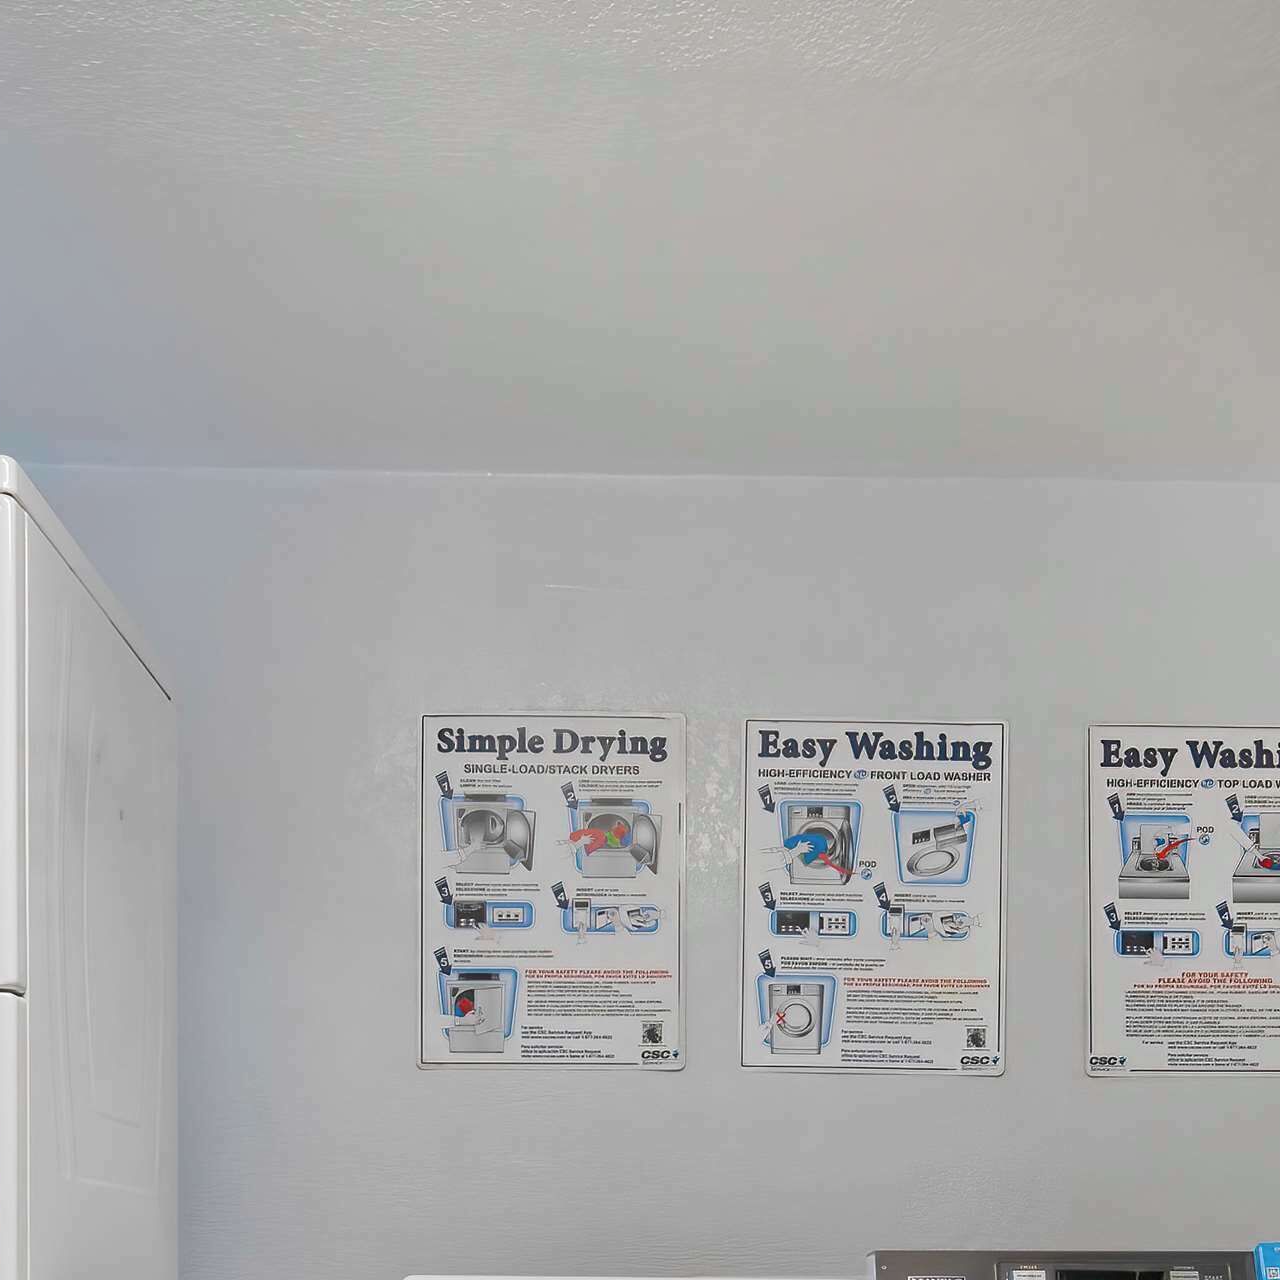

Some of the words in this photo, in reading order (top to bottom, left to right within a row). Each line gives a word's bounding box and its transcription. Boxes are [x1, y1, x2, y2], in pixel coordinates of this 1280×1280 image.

[437, 727, 544, 760] Simple
[553, 729, 668, 762] Drying
[758, 729, 838, 767] Easy
[846, 731, 993, 770] Washing
[1100, 740, 1178, 776] Easy
[464, 764, 588, 775] SINGLE-LOAD/STACK
[591, 765, 639, 775] DRYERS
[758, 769, 852, 779] HIGH-EFFICIENCY
[870, 771, 907, 780] FRONT
[910, 771, 941, 781] LOAD
[943, 772, 991, 782] WASHER
[1107, 779, 1199, 788] HIGH-EFFICIENCY
[1217, 780, 1239, 789] TOP
[1242, 780, 1273, 789] LOAD
[889, 795, 897, 805] 2
[1232, 805, 1239, 813] 2
[1196, 826, 1214, 834] POD
[858, 860, 877, 868] POD
[441, 887, 448, 896] 3
[440, 958, 447, 966] 5
[764, 959, 771, 969] 5
[641, 1050, 670, 1059] CSC
[961, 1056, 990, 1064] CSC
[1089, 1056, 1117, 1065] CSC
